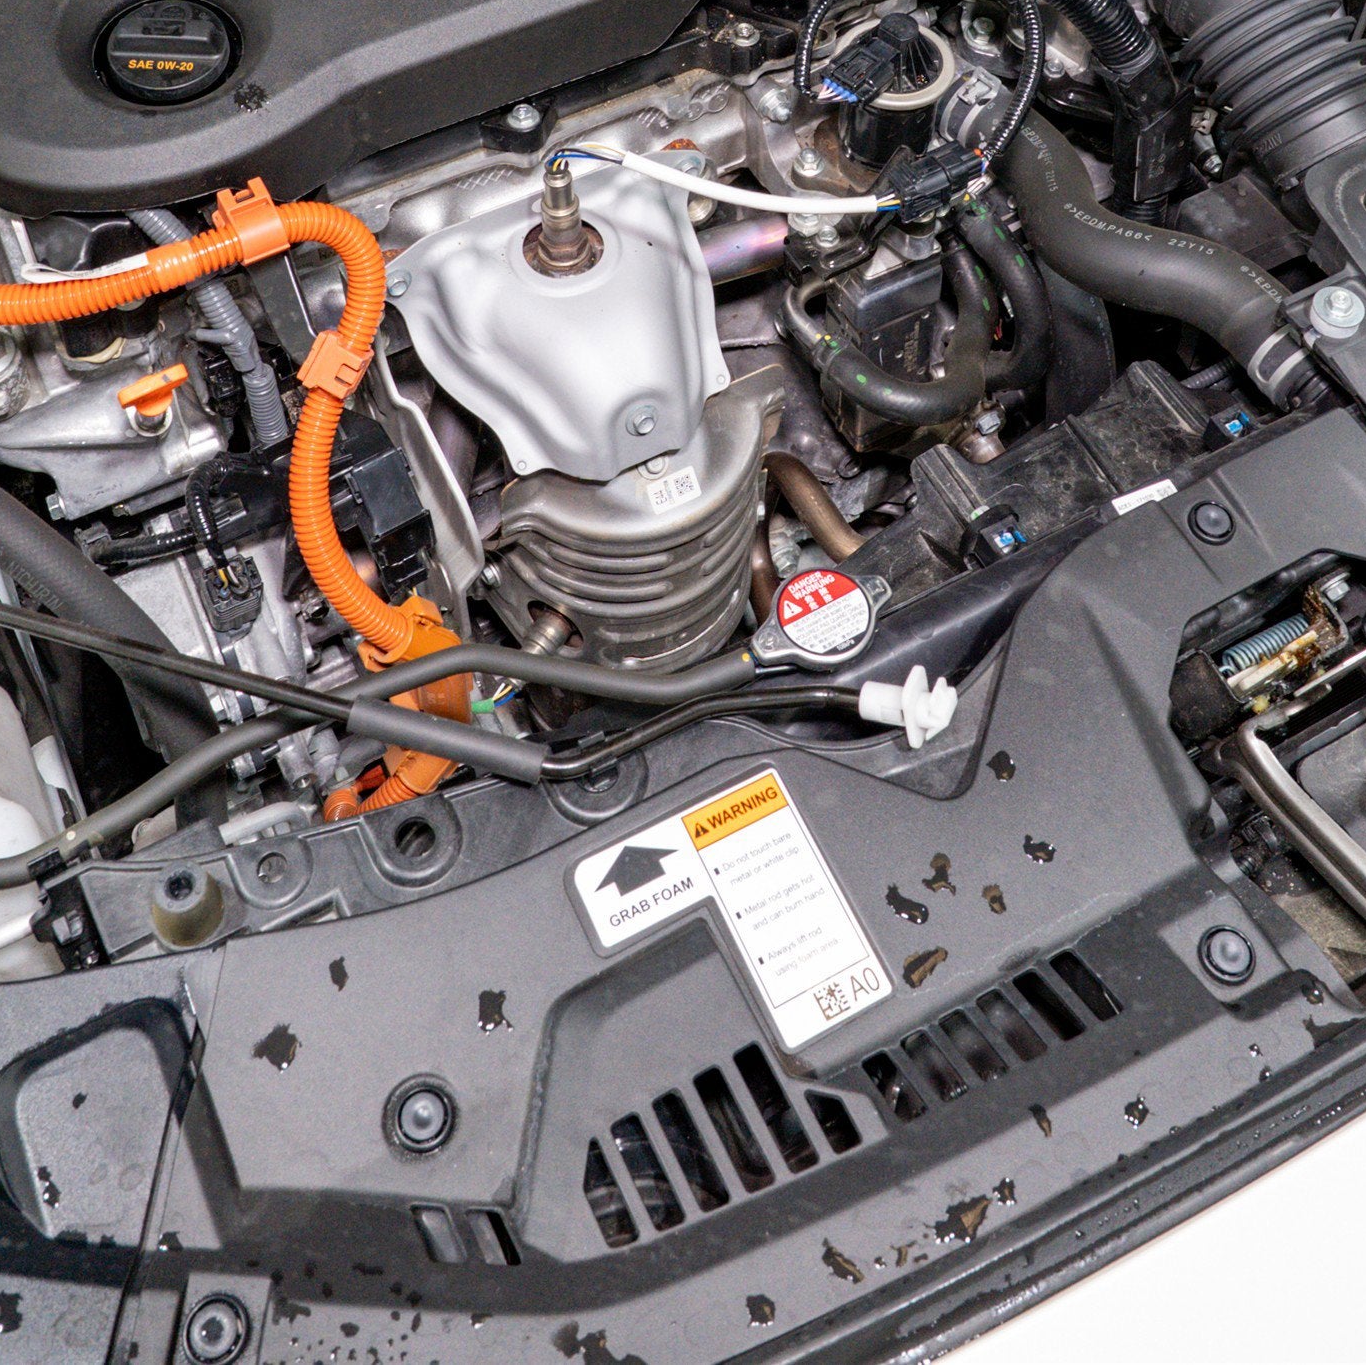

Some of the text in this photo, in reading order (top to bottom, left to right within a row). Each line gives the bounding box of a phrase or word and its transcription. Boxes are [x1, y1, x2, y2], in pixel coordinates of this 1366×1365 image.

[128, 59, 193, 71] SAE 0W-20
[1168, 238, 1214, 255] 22Y15
[788, 571, 823, 593] DANGER
[793, 575, 835, 600] WARNUNG
[707, 787, 778, 829] WARNING
[722, 833, 792, 871] Do not touch bare
[730, 846, 799, 886] metal or white clip
[609, 877, 694, 927] GRAB FOAM
[745, 875, 815, 915] Metal rod gets hot
[753, 888, 825, 930] and can burn hand
[768, 927, 822, 960] Always lift rod
[775, 939, 838, 976] using foam area
[849, 967, 880, 1002] A0
